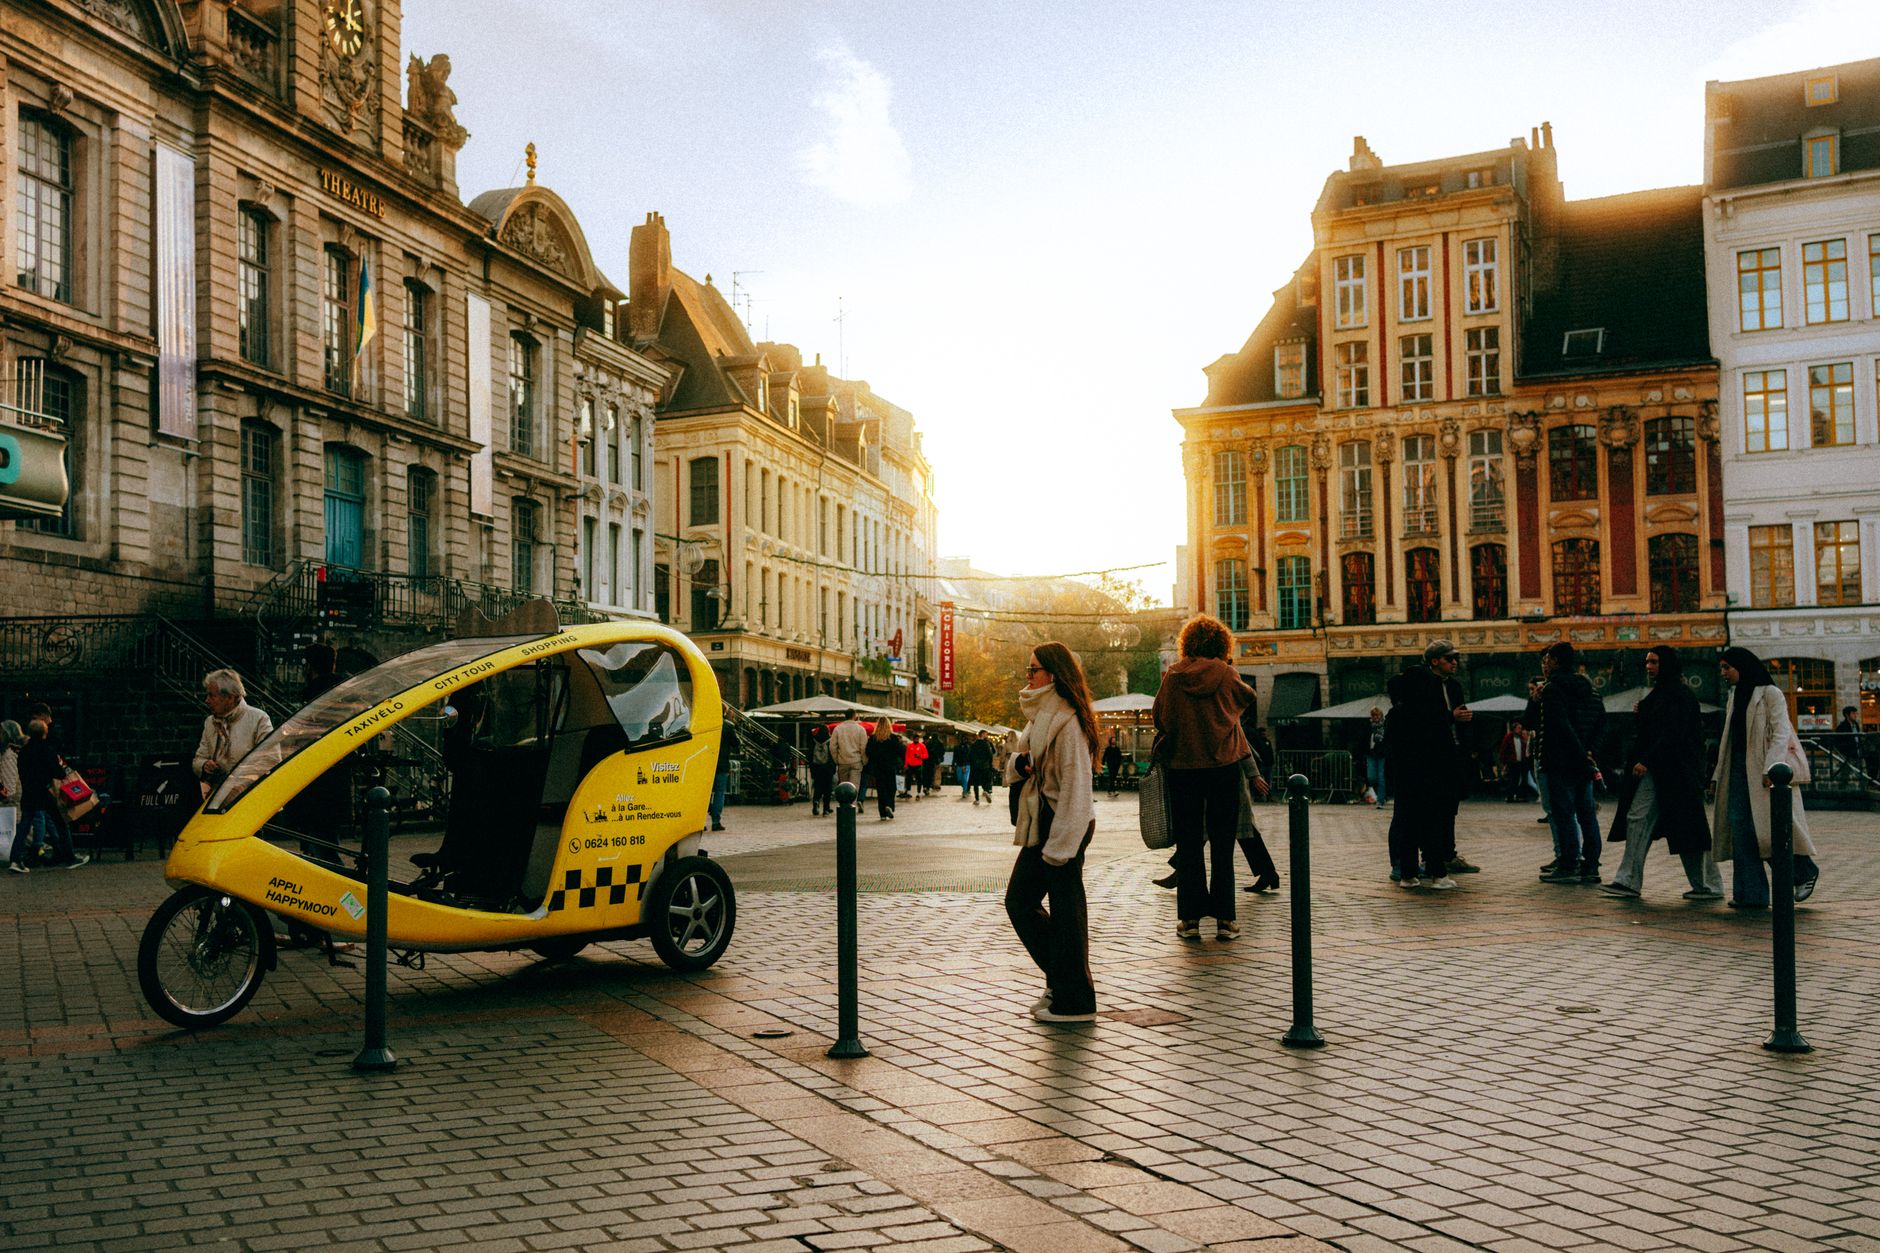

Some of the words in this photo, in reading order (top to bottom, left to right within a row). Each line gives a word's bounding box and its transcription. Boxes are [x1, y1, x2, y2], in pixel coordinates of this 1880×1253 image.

[321, 167, 386, 219] THEATRE
[344, 701, 404, 737] TAXIVÉLO
[434, 673, 460, 691] CITY
[461, 661, 495, 678] TOUR
[521, 634, 578, 656] SHOPPING
[651, 763, 679, 772] Visitez
[652, 774, 660, 784] la
[662, 773, 679, 783] ville
[140, 794, 160, 806] FULL
[164, 793, 180, 805] VAP
[611, 804, 617, 812] à
[618, 803, 625, 811] la
[637, 811, 681, 820] Rendez-vous
[585, 838, 608, 848] 0624
[611, 836, 627, 847] 160
[630, 835, 645, 845] 818
[268, 877, 303, 895] APPLI
[265, 889, 338, 917] HAPPYMOOV
